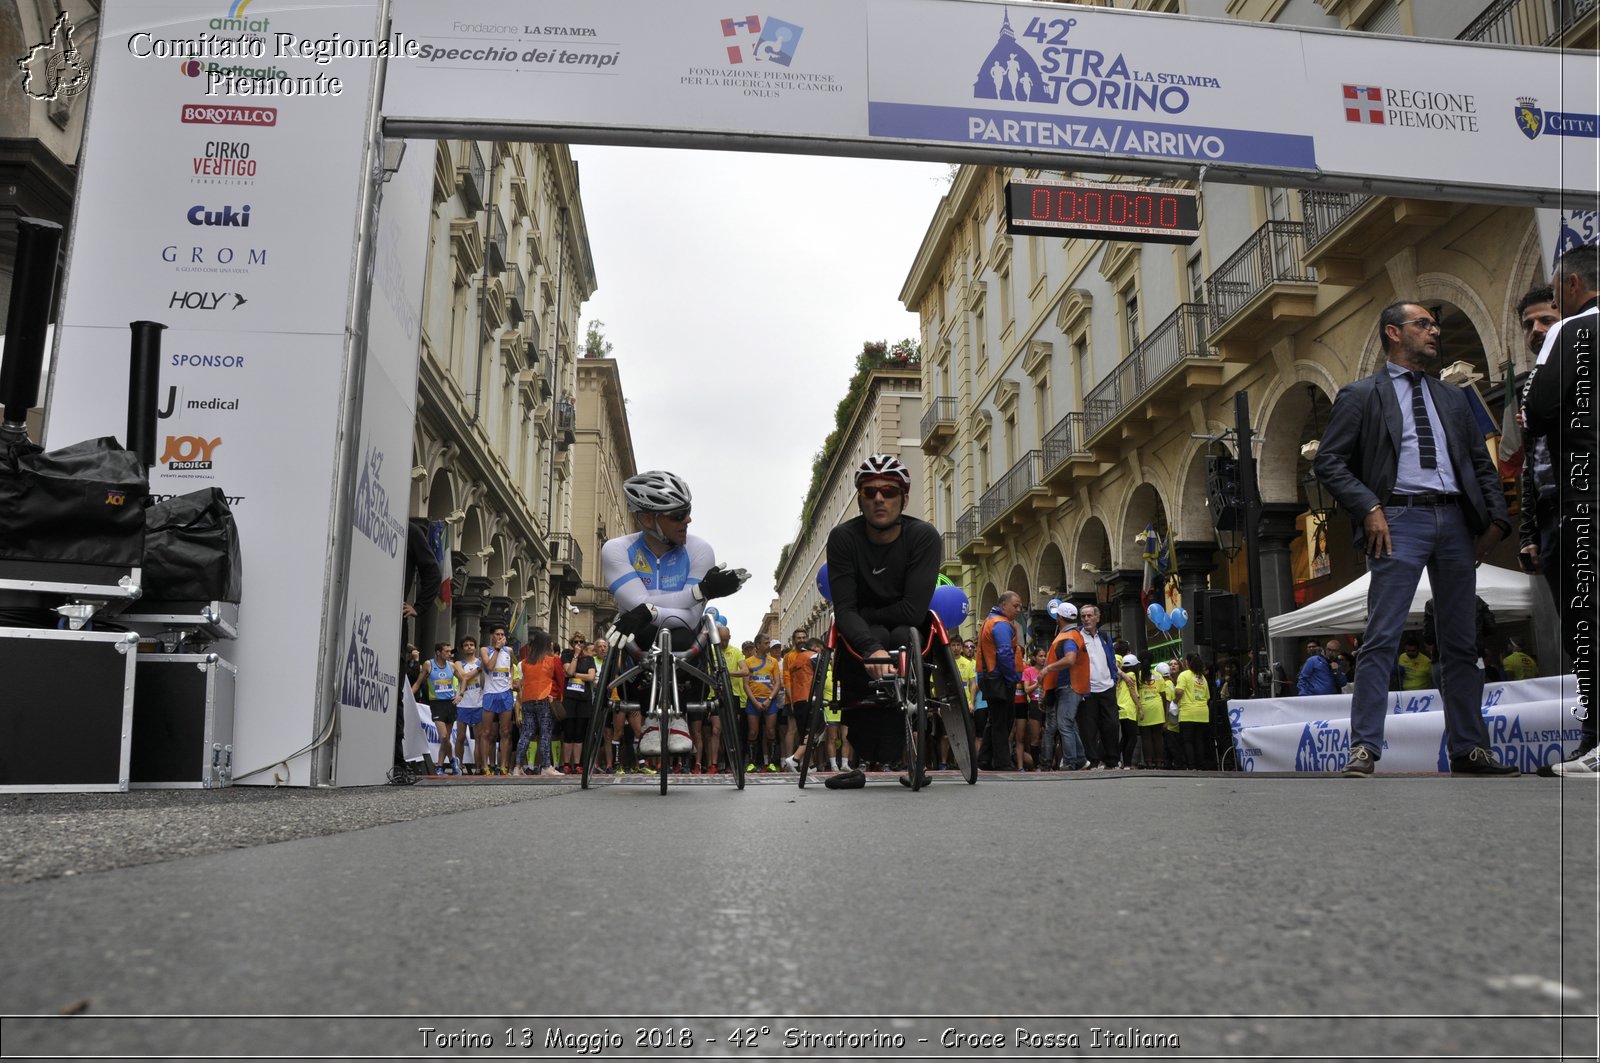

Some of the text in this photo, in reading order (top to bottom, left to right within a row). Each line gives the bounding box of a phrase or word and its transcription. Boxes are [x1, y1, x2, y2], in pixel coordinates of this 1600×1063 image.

[209, 17, 270, 33] amiat
[453, 21, 597, 37] Fondazione LA STAMPA
[1023, 16, 1077, 46] 42°
[418, 44, 620, 68] Specchio dei tempi
[1040, 46, 1222, 88] STRA LA STAMPA
[208, 61, 288, 82] Battaglio
[688, 68, 835, 82] FONDAZIONE PIEMONTESE
[680, 76, 844, 92] PER LA RICERCA SUL CANCRO
[744, 90, 780, 98] ONLUS
[1048, 76, 1190, 115] TORINO
[1386, 88, 1477, 114] REGIONE
[184, 108, 275, 124] BOROTALCO
[1388, 110, 1479, 133] PIEMONTE
[968, 116, 1225, 158] PARTENZA/ARRIVO
[205, 141, 250, 159] CIRKO
[193, 158, 257, 176] VERTIGO
[187, 204, 251, 227] Cuki
[1032, 188, 1177, 227] 00:00:00
[162, 246, 266, 265] GROM
[168, 291, 227, 310] HOLY
[172, 354, 244, 368] SPONSOR
[158, 386, 240, 419] J medical
[160, 436, 222, 465] JOY
[370, 480, 389, 519] STRA
[370, 510, 398, 560] TORINO
[360, 646, 379, 682] STRA
[360, 678, 389, 714] TORINO
[1228, 706, 1244, 728] 2°
[1317, 729, 1350, 752] STRA
[1524, 732, 1540, 742] LA
[1541, 730, 1584, 742] STAMP
[1491, 744, 1564, 773] ORINO
